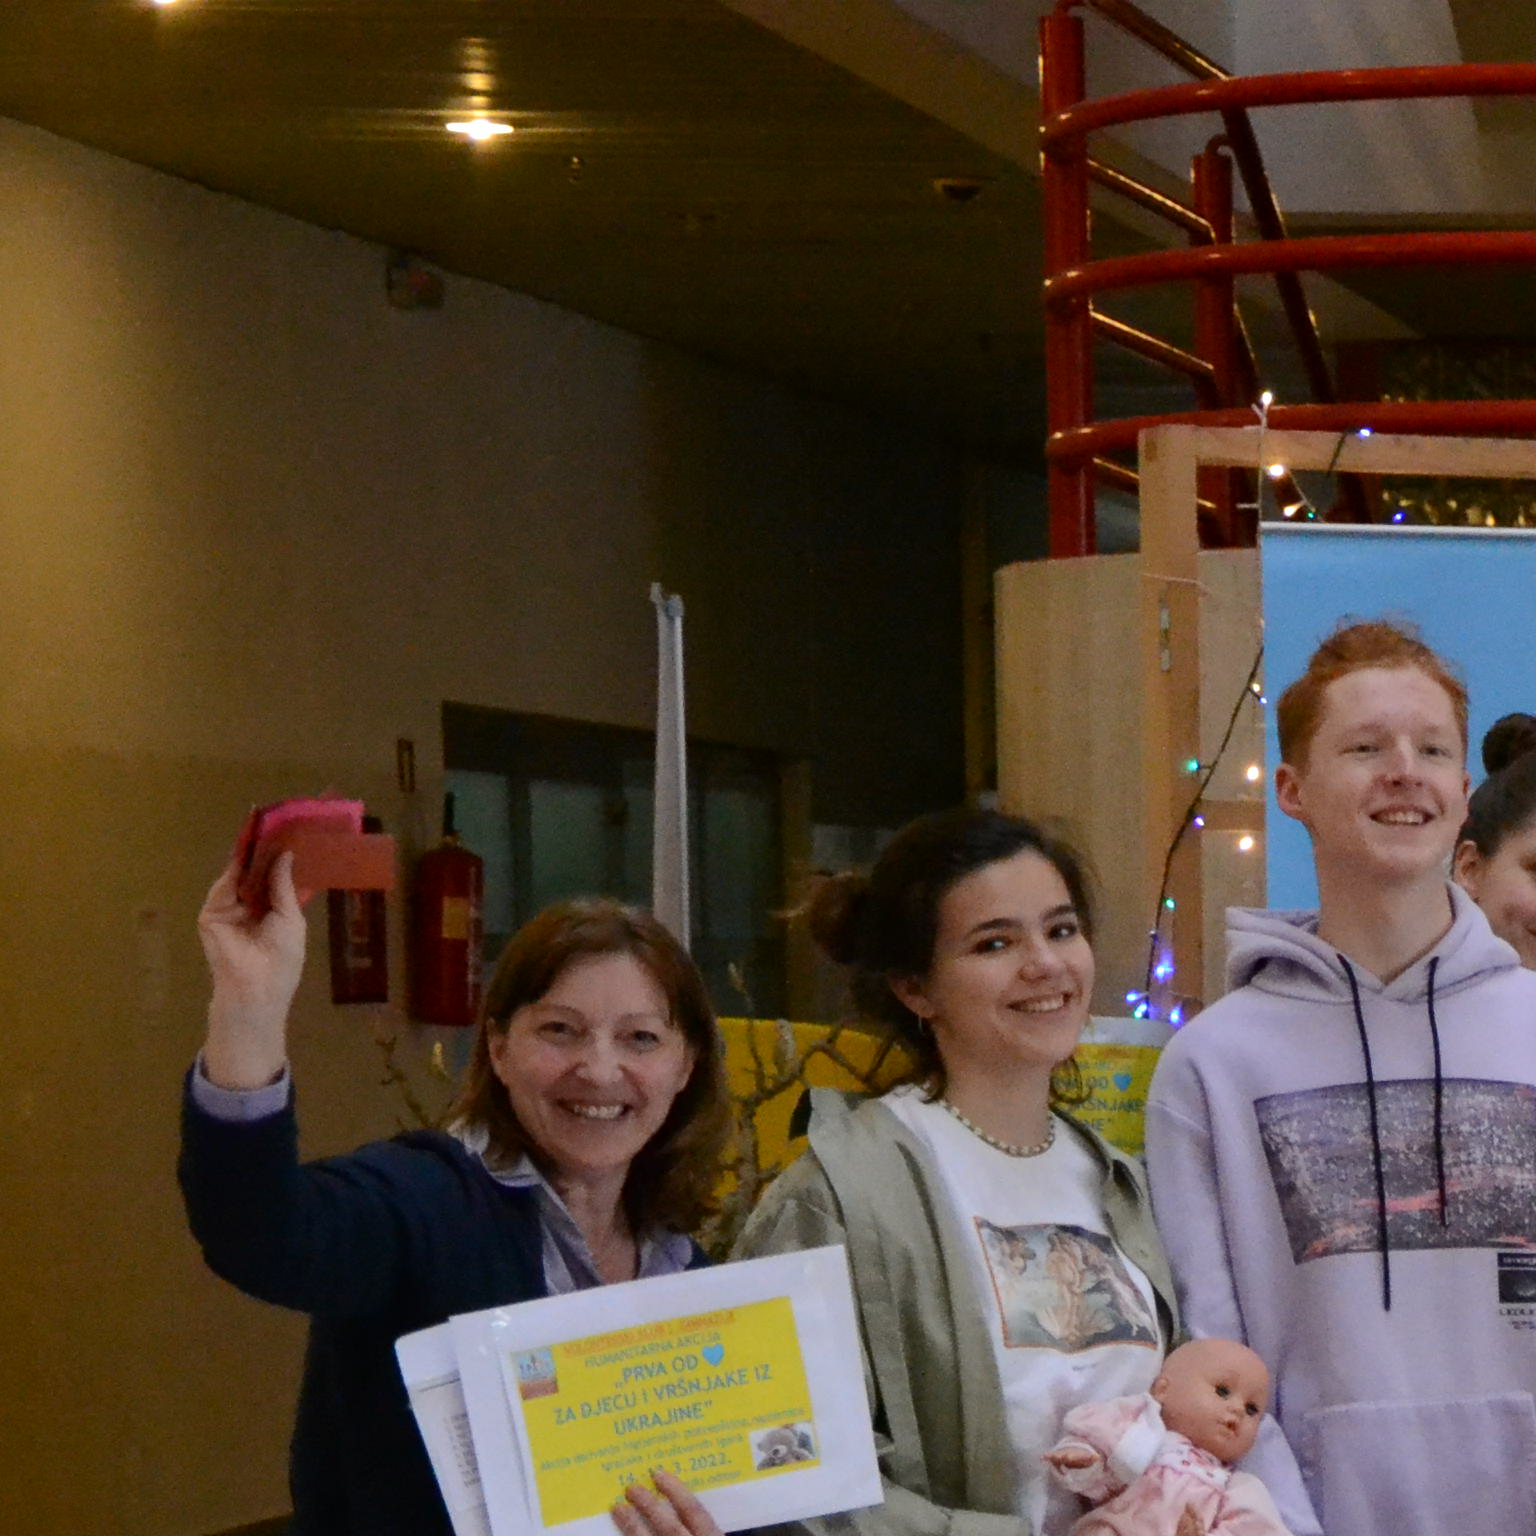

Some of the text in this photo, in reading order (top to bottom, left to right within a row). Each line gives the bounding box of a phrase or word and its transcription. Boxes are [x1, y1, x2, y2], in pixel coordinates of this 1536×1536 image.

[672, 1354, 698, 1374] OD
[554, 1406, 577, 1425] ZA
[581, 1392, 636, 1419] DJECU
[654, 1368, 748, 1401] VRŠNJAKE
[754, 1364, 773, 1382] IZ
